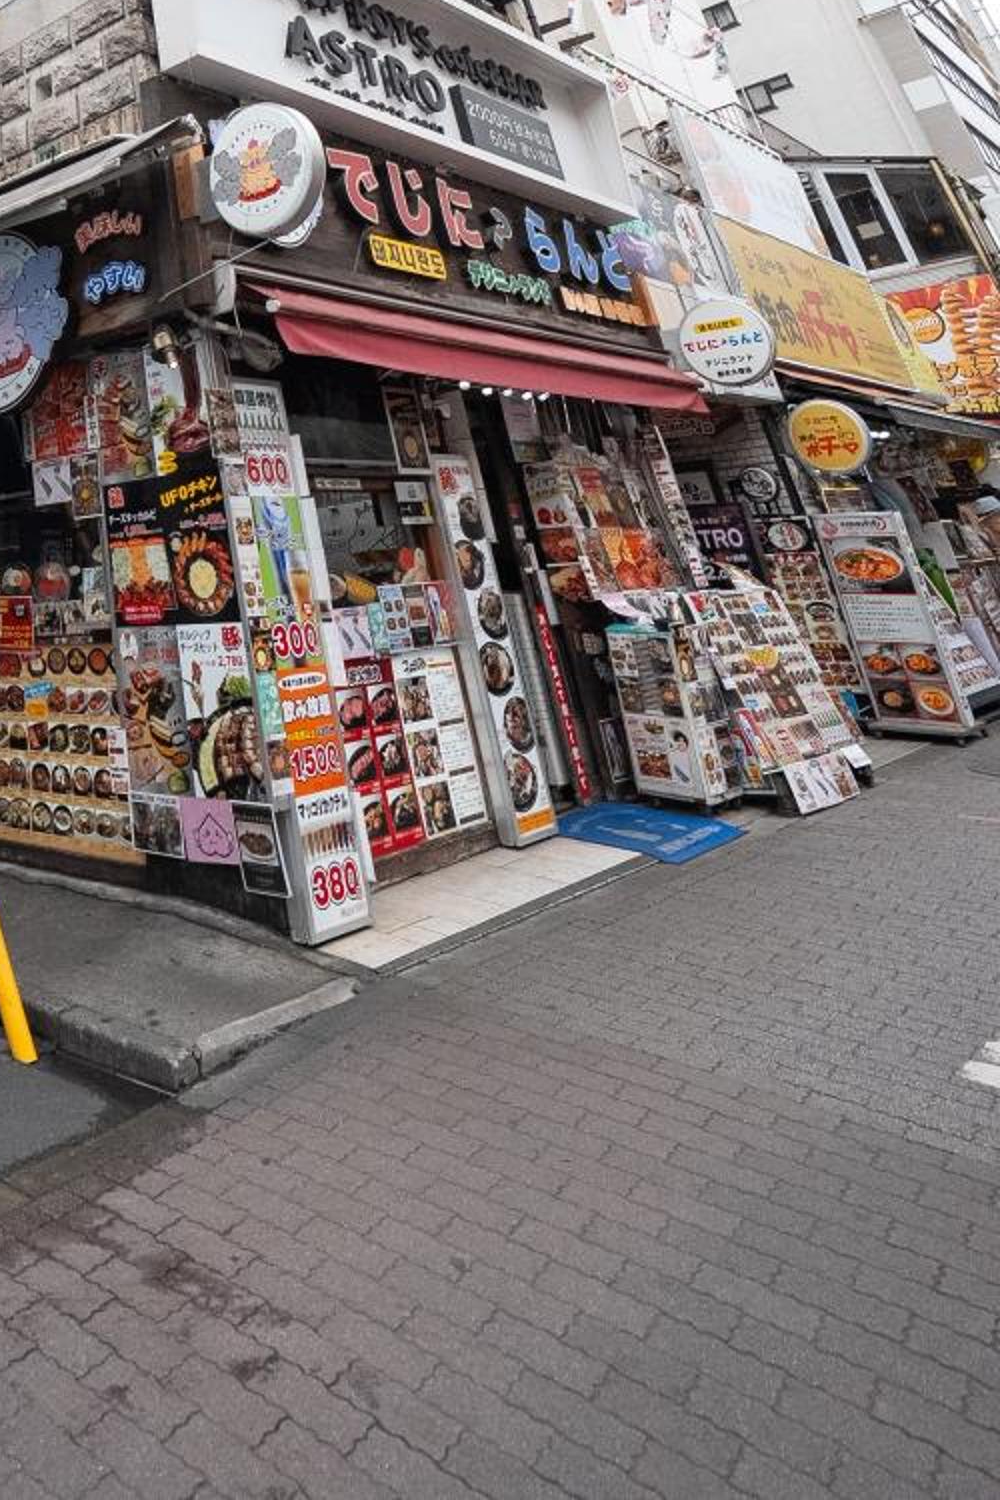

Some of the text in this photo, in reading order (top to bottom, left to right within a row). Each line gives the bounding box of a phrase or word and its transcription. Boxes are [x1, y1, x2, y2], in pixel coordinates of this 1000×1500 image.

[284, 15, 447, 115] ASTRO
[247, 456, 288, 484] 600
[697, 527, 744, 549] TRO
[272, 621, 317, 657] 300
[312, 858, 359, 910] 380
